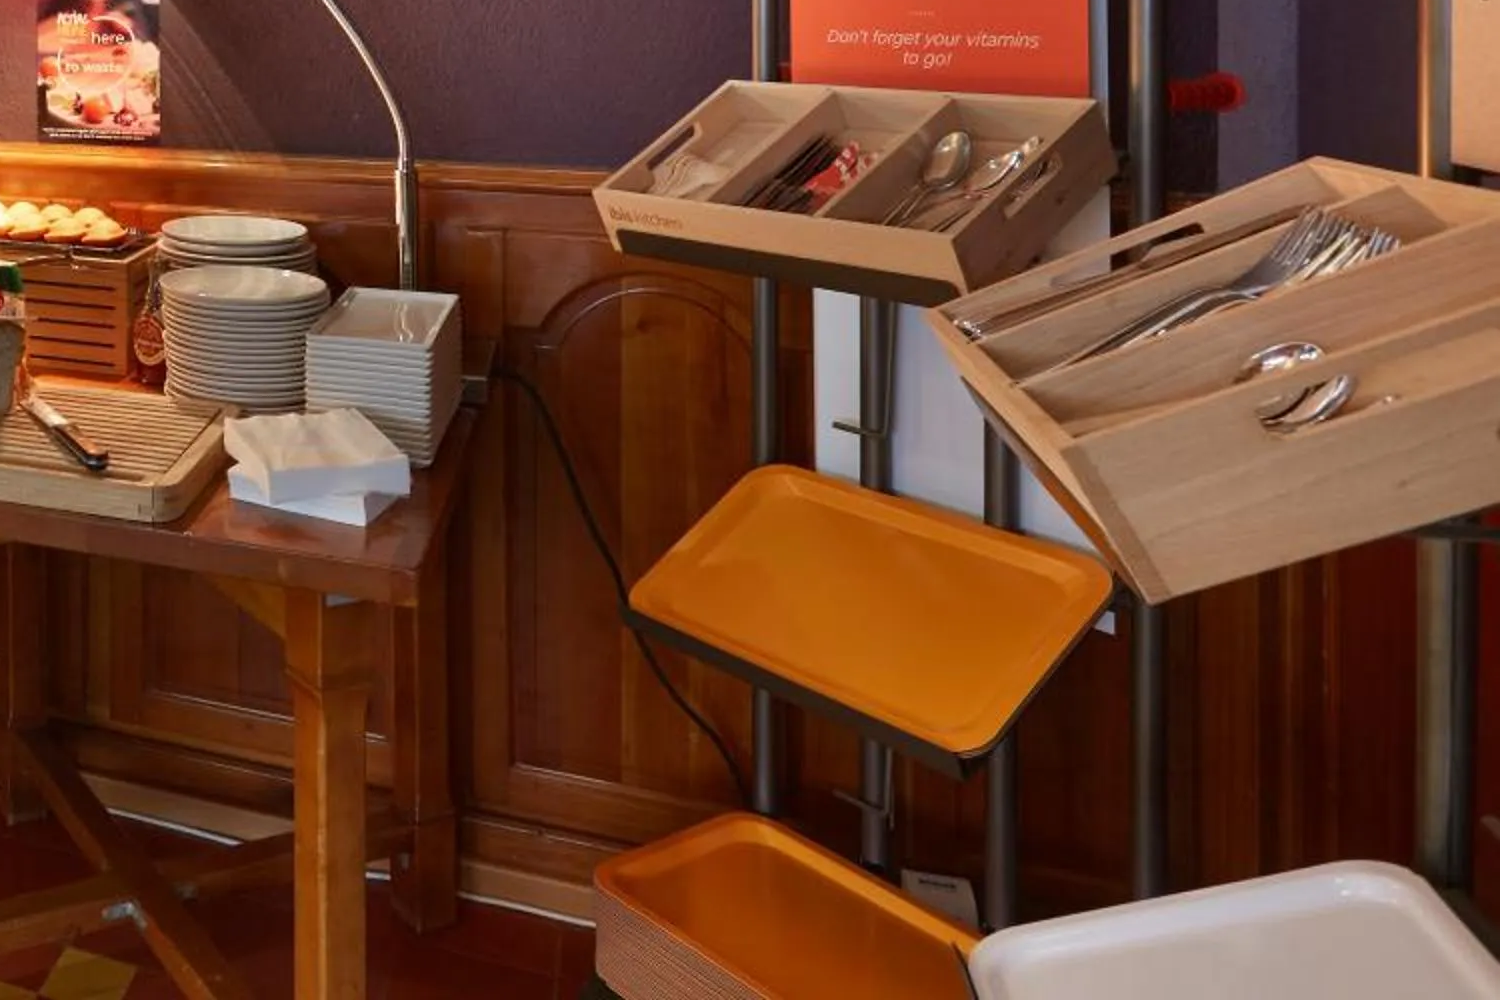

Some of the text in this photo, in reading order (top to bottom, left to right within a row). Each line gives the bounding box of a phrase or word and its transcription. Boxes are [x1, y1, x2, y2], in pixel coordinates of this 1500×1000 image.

[826, 28, 1040, 49] Don't forget your vitamins
[902, 51, 953, 69] to go!
